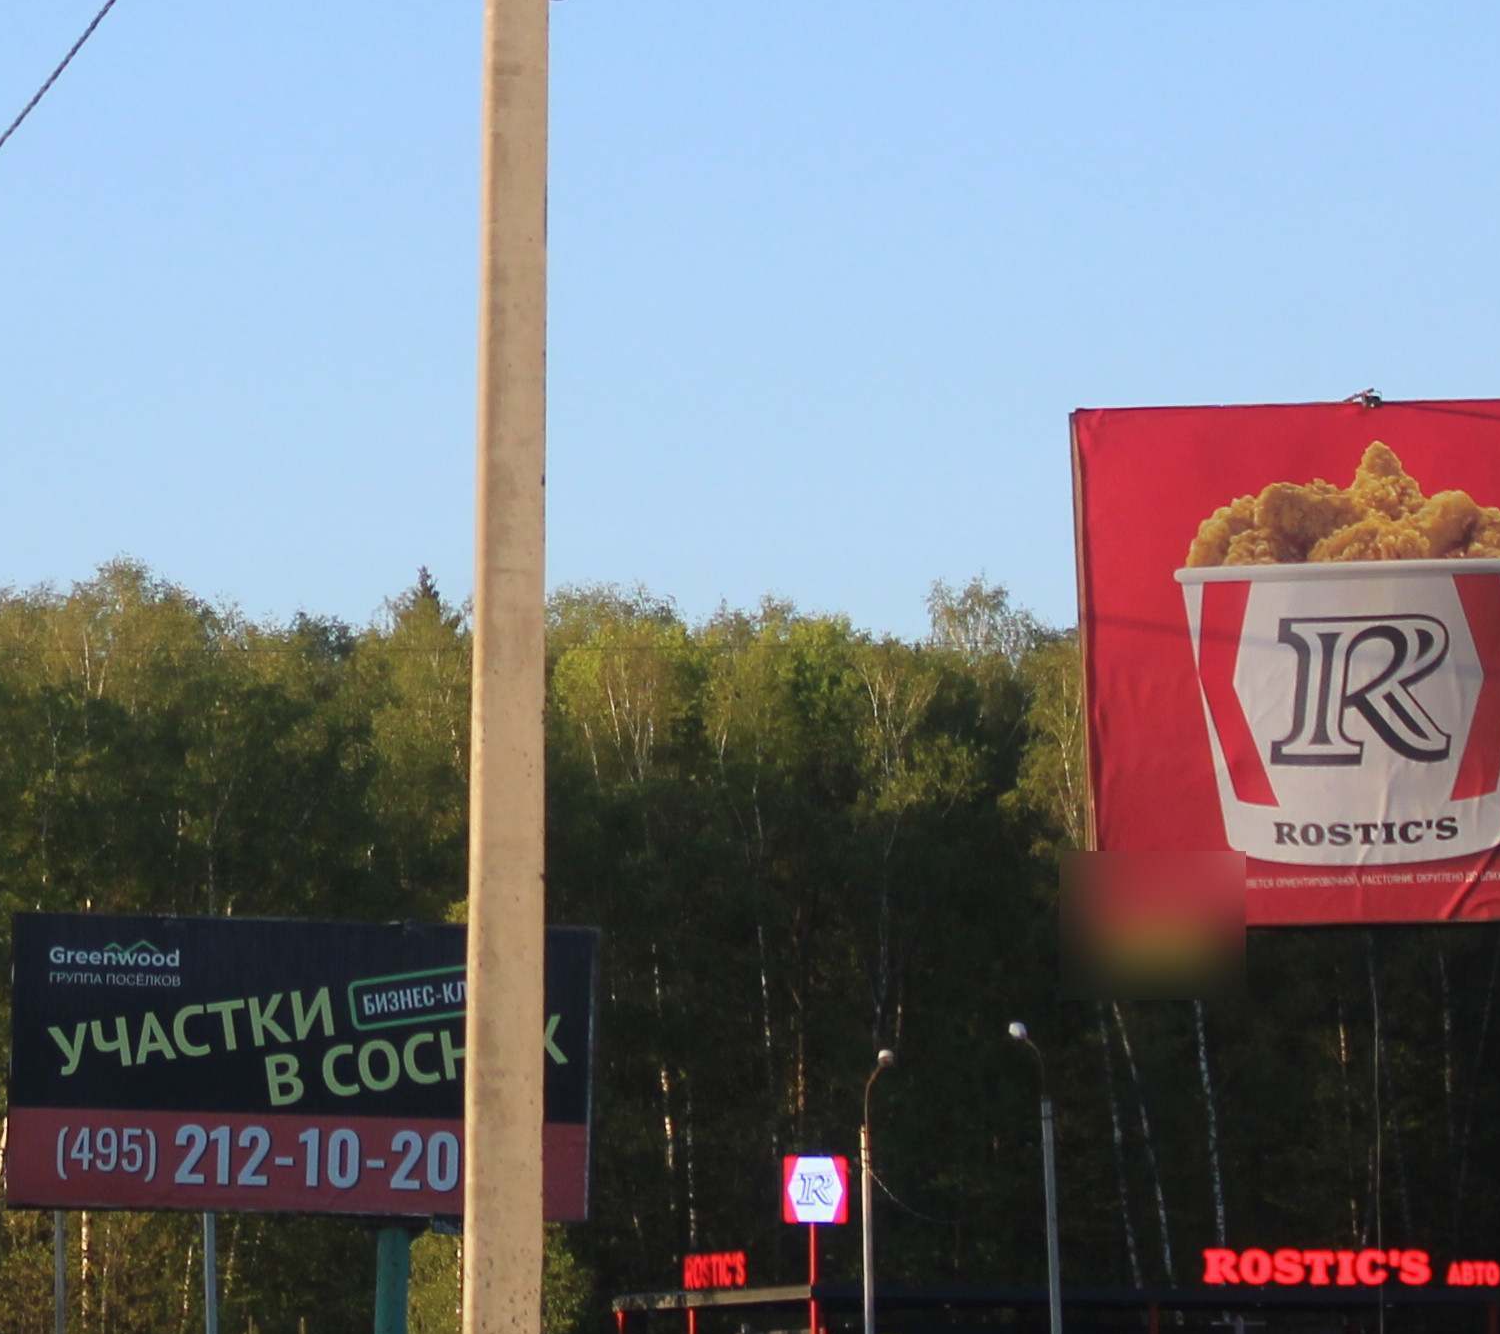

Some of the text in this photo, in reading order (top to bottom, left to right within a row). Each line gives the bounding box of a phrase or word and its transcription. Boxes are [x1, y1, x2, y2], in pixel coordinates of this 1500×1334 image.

[1273, 817, 1459, 846] ROSTIC'S
[49, 946, 180, 967] Greenwood
[49, 971, 102, 985] ГРУППА
[363, 981, 467, 1016] БИЗНЕС-КЛ
[47, 987, 335, 1076] УЧАСТКИ
[265, 1053, 304, 1106] В
[57, 1124, 460, 1192] (495) 212-10-20
[1202, 1248, 1433, 1286] ROSTIC'S
